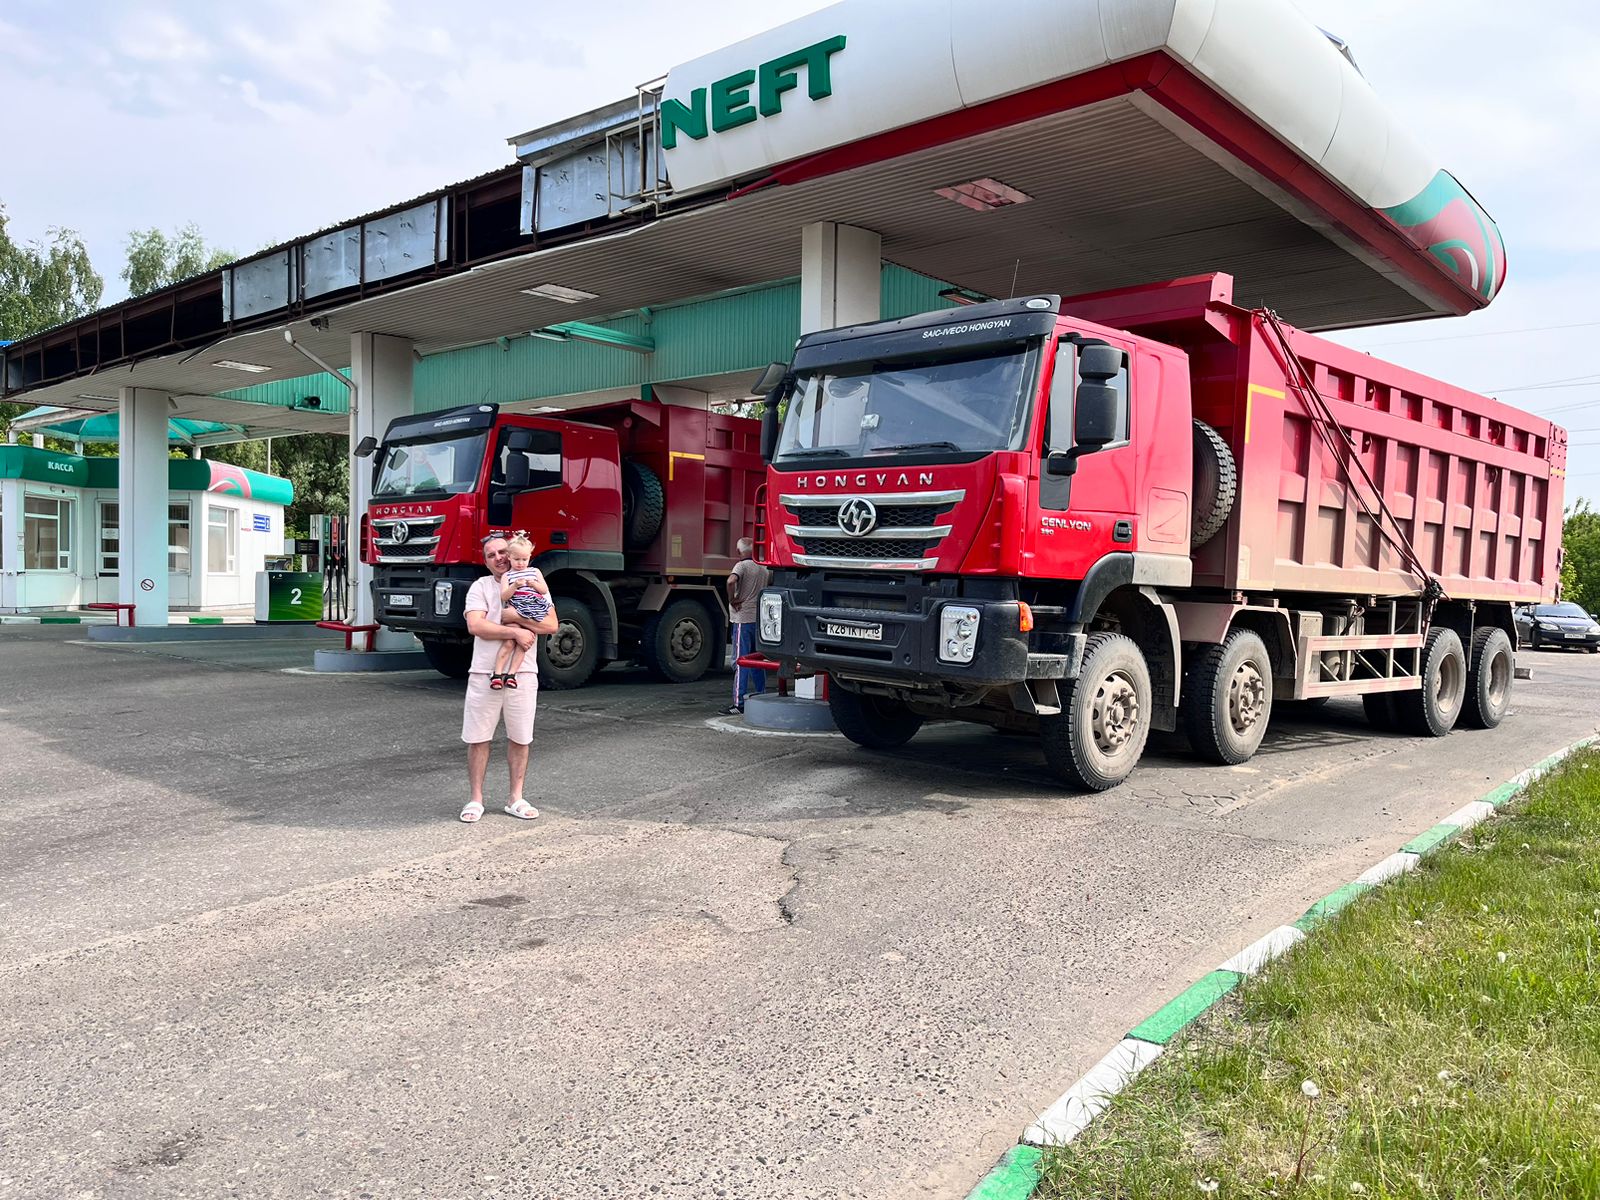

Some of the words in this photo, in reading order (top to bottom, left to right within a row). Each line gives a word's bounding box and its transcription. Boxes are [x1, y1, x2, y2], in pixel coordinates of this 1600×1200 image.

[661, 35, 847, 150] NEFT
[922, 326, 968, 338] SAIC-IVECO
[968, 320, 1011, 331] HONGYAN
[47, 461, 74, 473] КАССА
[797, 472, 934, 488] HONGYAN
[376, 505, 433, 515] HONGYAN
[290, 588, 302, 605] 2
